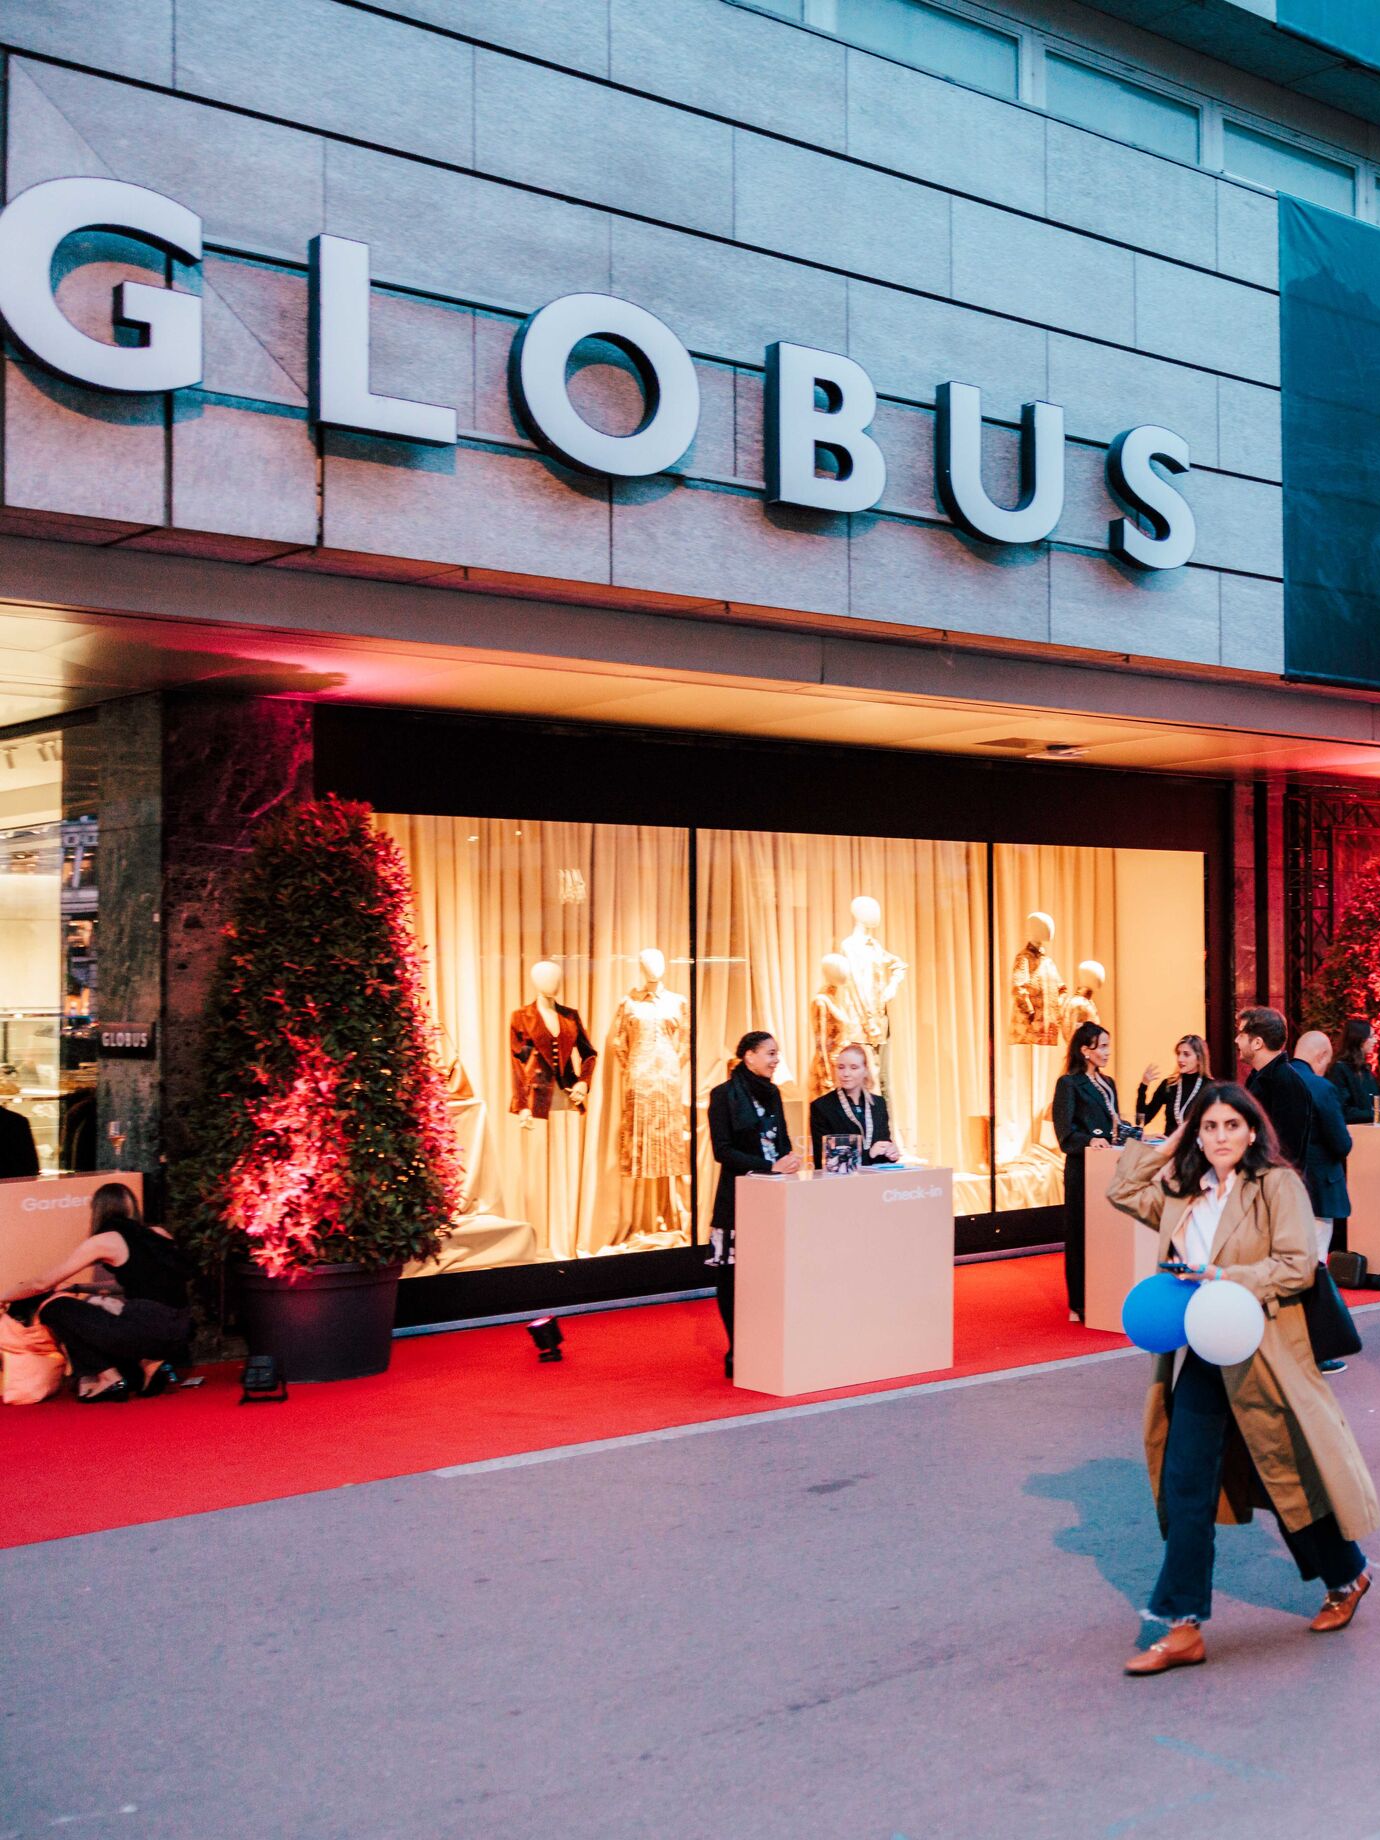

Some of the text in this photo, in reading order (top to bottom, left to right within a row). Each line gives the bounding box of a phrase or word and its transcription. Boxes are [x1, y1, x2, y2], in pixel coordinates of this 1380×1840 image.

[0, 177, 1197, 570] GLOBUS
[102, 1032, 148, 1047] GLOBUS
[882, 1184, 944, 1203] Check-in
